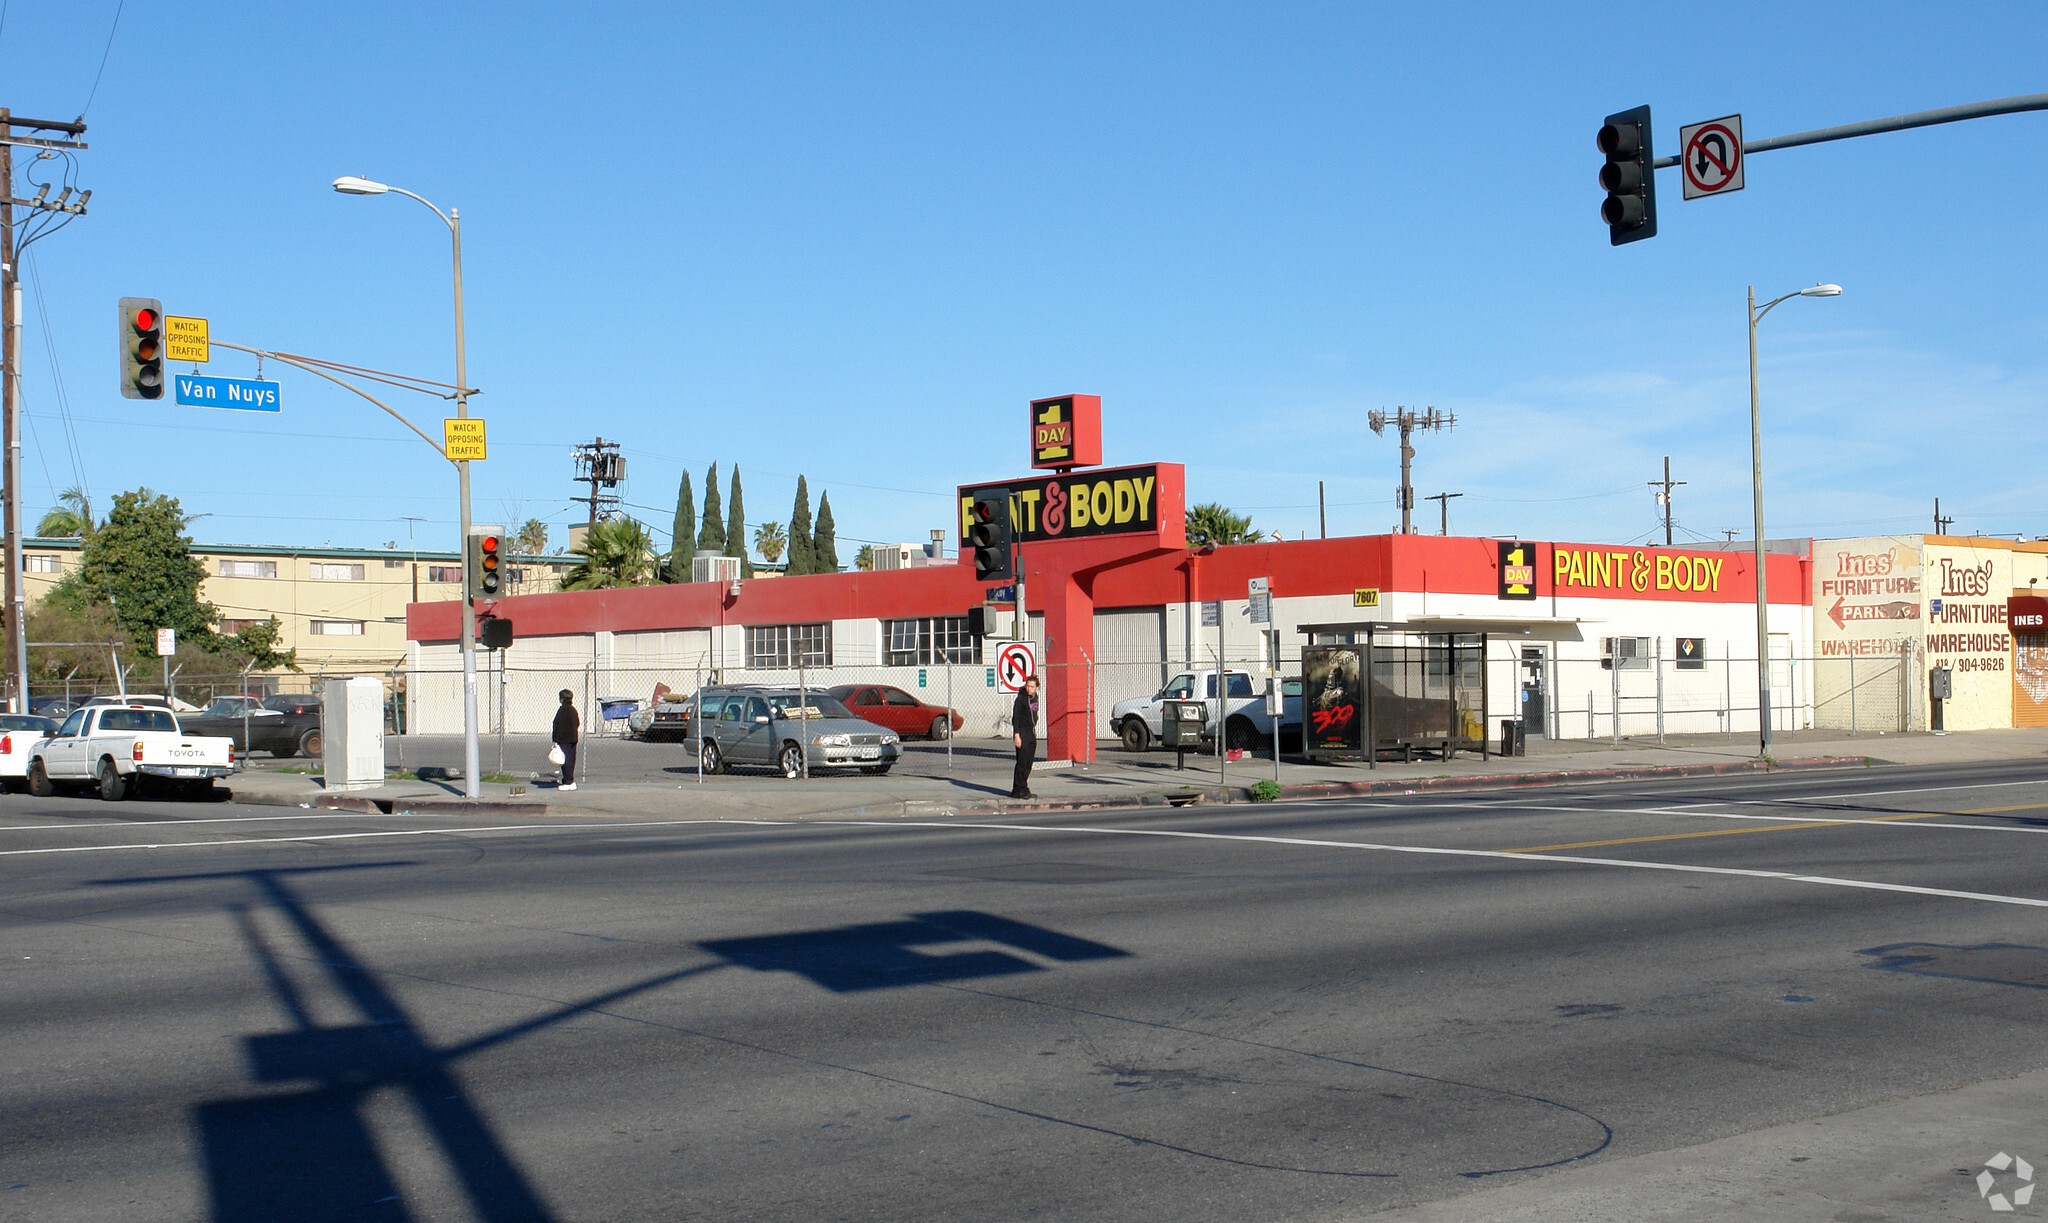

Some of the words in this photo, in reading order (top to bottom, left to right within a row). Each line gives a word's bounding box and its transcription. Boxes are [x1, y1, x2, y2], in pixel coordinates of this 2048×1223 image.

[173, 322, 199, 332] WATCH
[168, 333, 206, 345] OPPOSING
[171, 345, 203, 357] TRAFFIC
[180, 380, 216, 399] Van
[228, 383, 276, 407] Nuys
[452, 424, 477, 432] WATCH
[1039, 404, 1068, 460] 1
[447, 434, 484, 444] OPPOSING
[1038, 426, 1067, 445] DAY
[451, 446, 481, 455] TRAFFIC
[961, 488, 1041, 539] PNT
[1042, 481, 1068, 536] &
[1070, 476, 1155, 529] BODY
[1506, 568, 1531, 582] DAY
[1507, 548, 1530, 595] 1
[1554, 549, 1629, 588] PAINT
[1630, 550, 1651, 592] &
[1655, 554, 1723, 592] BODY
[1940, 557, 1993, 597] Ines'
[1822, 577, 1920, 597] FURNITURE
[1355, 591, 1377, 604] 7607
[1842, 606, 1912, 619] PARKG
[2014, 615, 2044, 626] INES
[1926, 633, 2010, 653] WAREHOUSE
[1958, 657, 2005, 672] 904-9626
[1312, 704, 1355, 734] 300
[168, 750, 206, 758] TOYOTA
